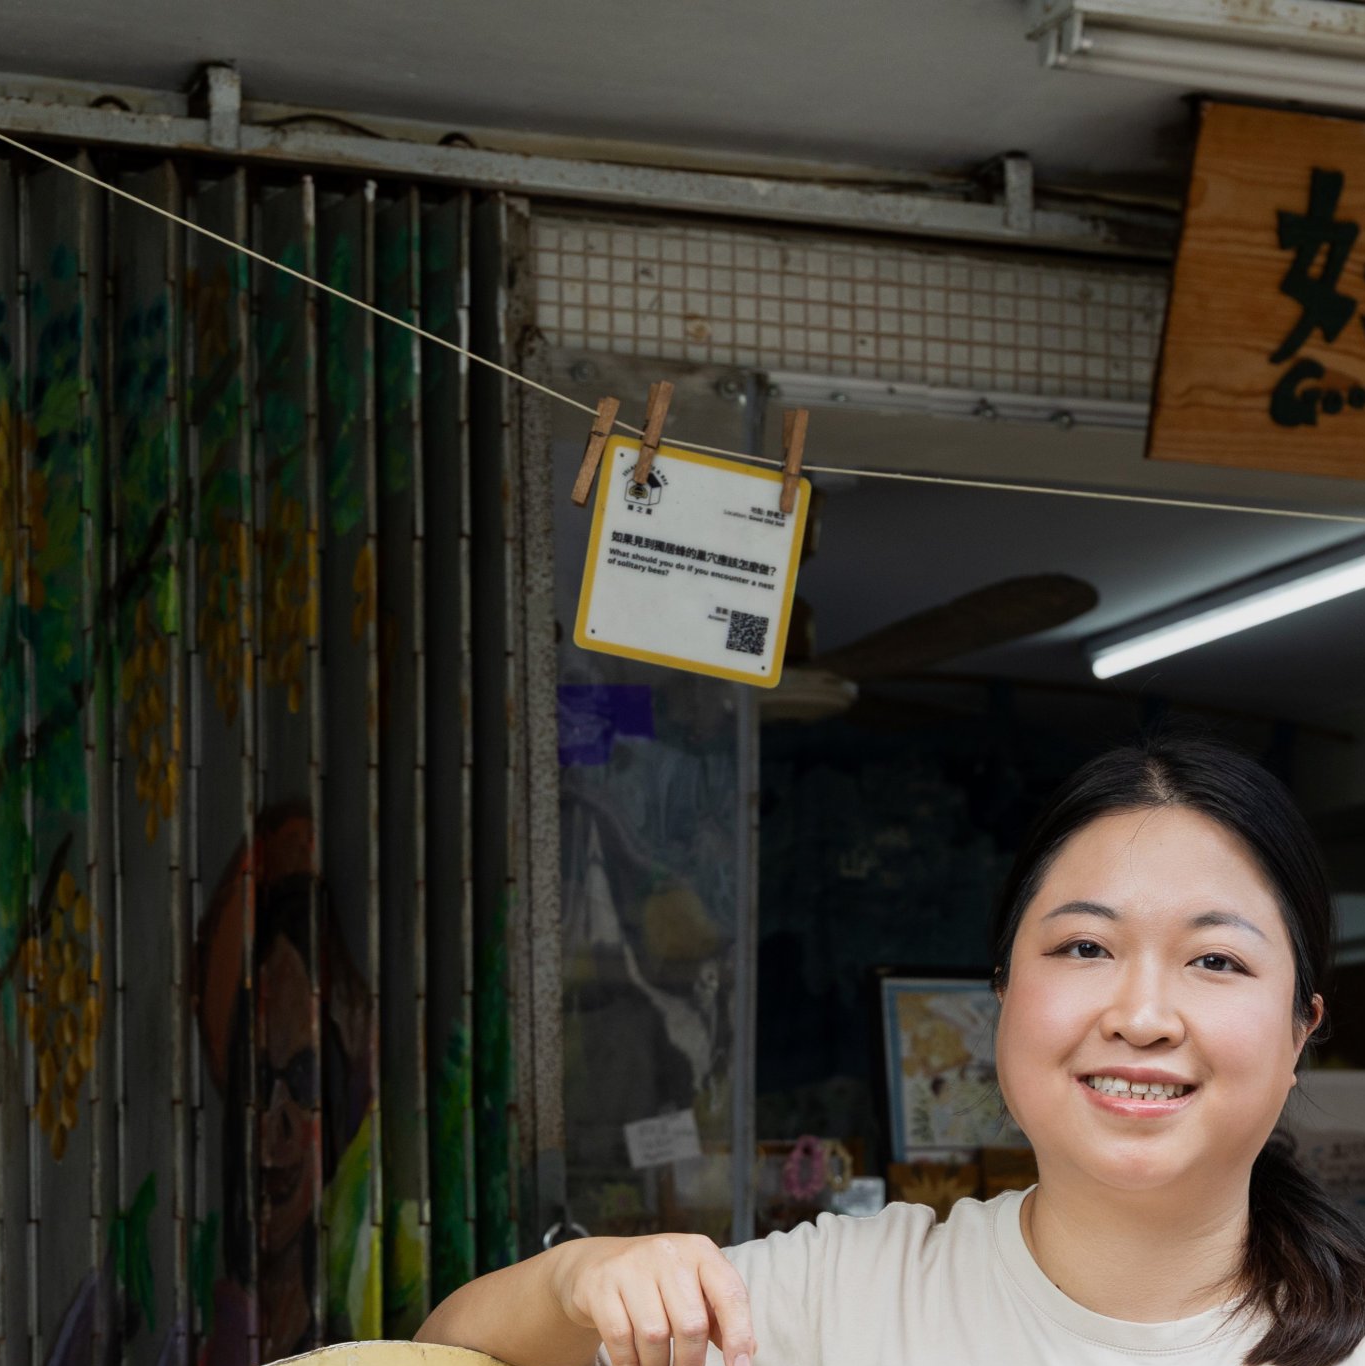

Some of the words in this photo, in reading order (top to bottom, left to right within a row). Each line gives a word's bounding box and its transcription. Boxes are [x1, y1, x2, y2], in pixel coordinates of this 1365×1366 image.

[607, 558, 616, 566] of
[617, 559, 646, 573] solitary
[647, 564, 670, 577] bees?
[609, 547, 630, 559] What
[631, 552, 658, 565] should
[659, 559, 674, 569] you
[675, 562, 686, 570] do
[687, 564, 694, 573] if
[694, 567, 709, 577] you
[710, 571, 750, 585] encounter
[758, 581, 775, 591] nest
